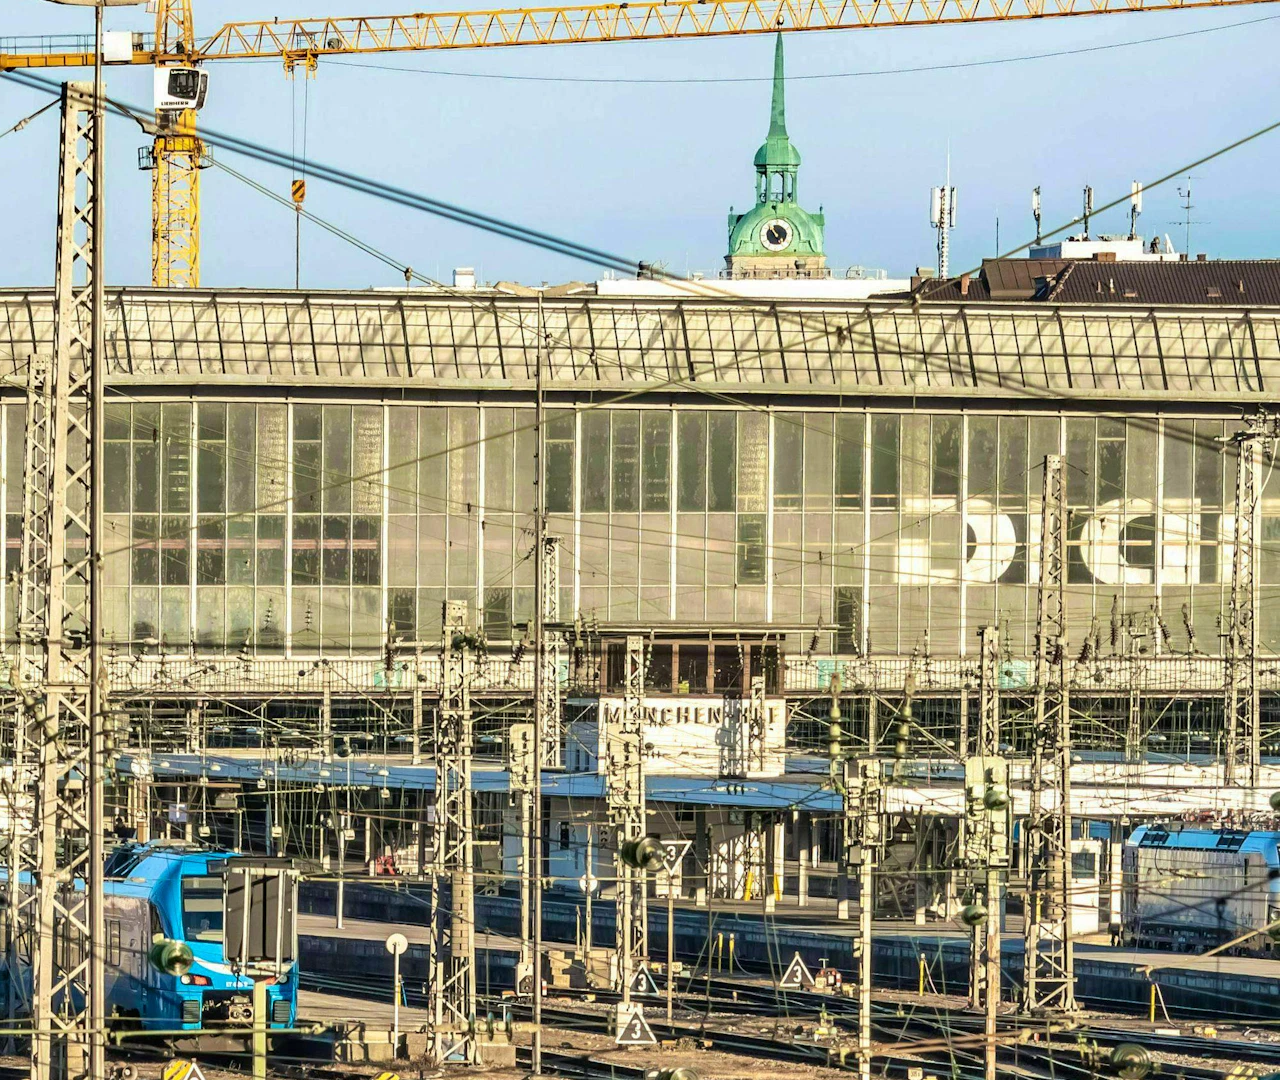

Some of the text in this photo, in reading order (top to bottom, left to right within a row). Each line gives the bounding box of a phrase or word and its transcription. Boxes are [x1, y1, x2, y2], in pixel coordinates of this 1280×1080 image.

[605, 706, 722, 724] MNCHEN
[667, 844, 676, 861] 3
[637, 974, 646, 991] 3
[793, 965, 802, 983] 3
[630, 1019, 640, 1039] 3
